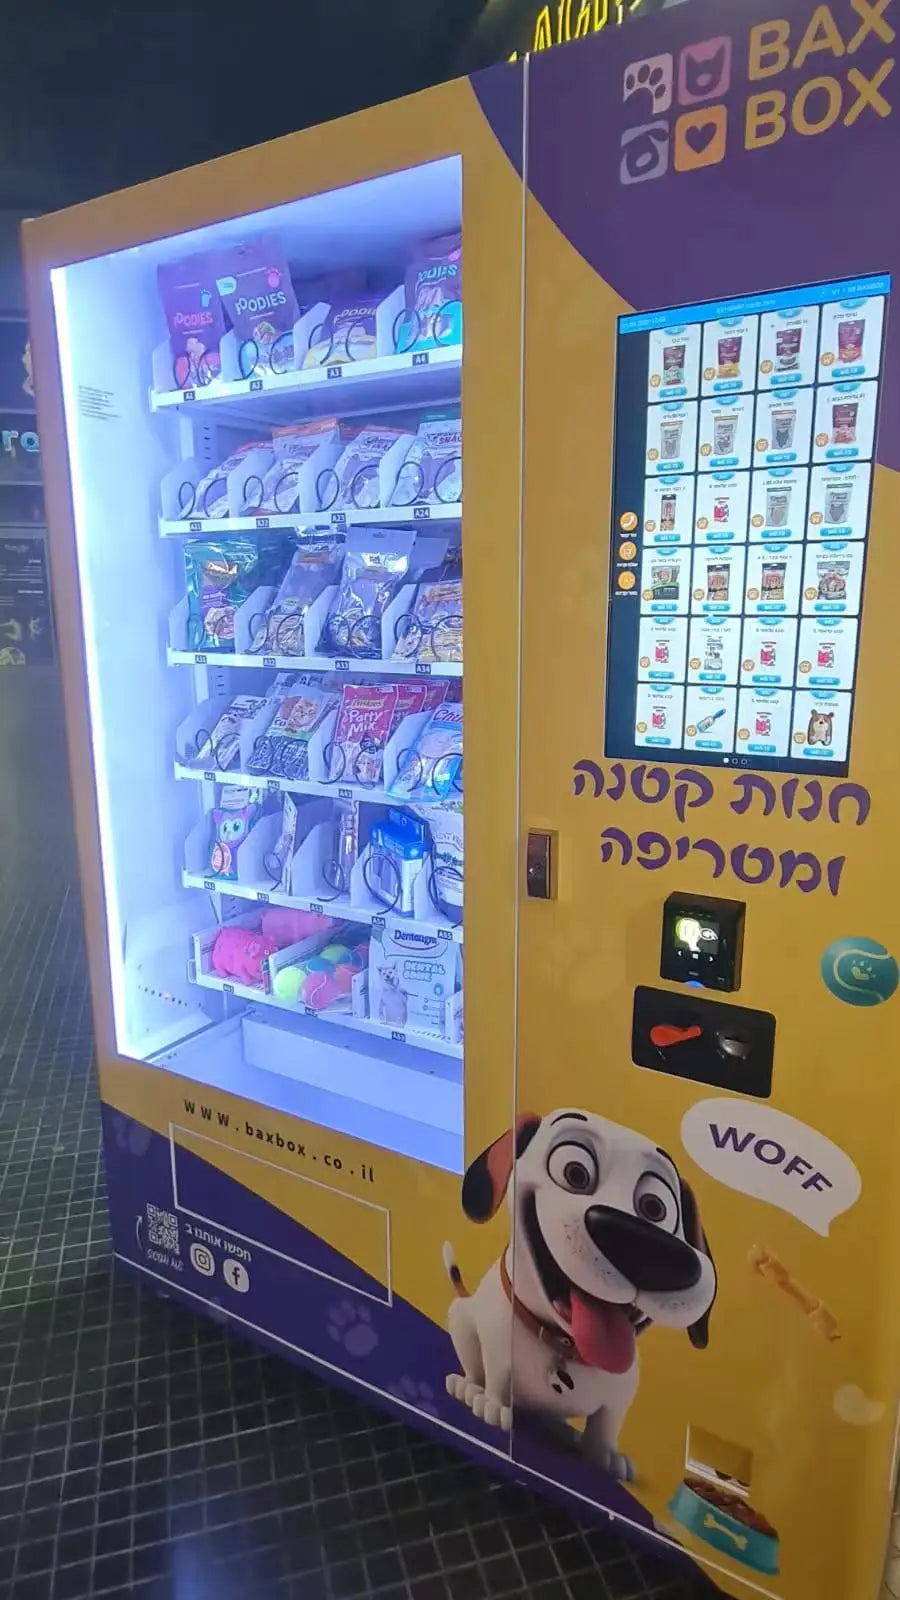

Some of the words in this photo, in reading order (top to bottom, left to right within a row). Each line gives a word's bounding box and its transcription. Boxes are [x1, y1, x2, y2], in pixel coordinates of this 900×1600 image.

[747, 0, 896, 81] BAX
[744, 58, 896, 150] BOX
[348, 709, 383, 722] Party
[349, 722, 377, 733] Mix
[573, 759, 714, 823] קטנה
[729, 773, 871, 826] חנות
[600, 826, 846, 896] ומטריפה
[709, 1123, 833, 1192] WOFF
